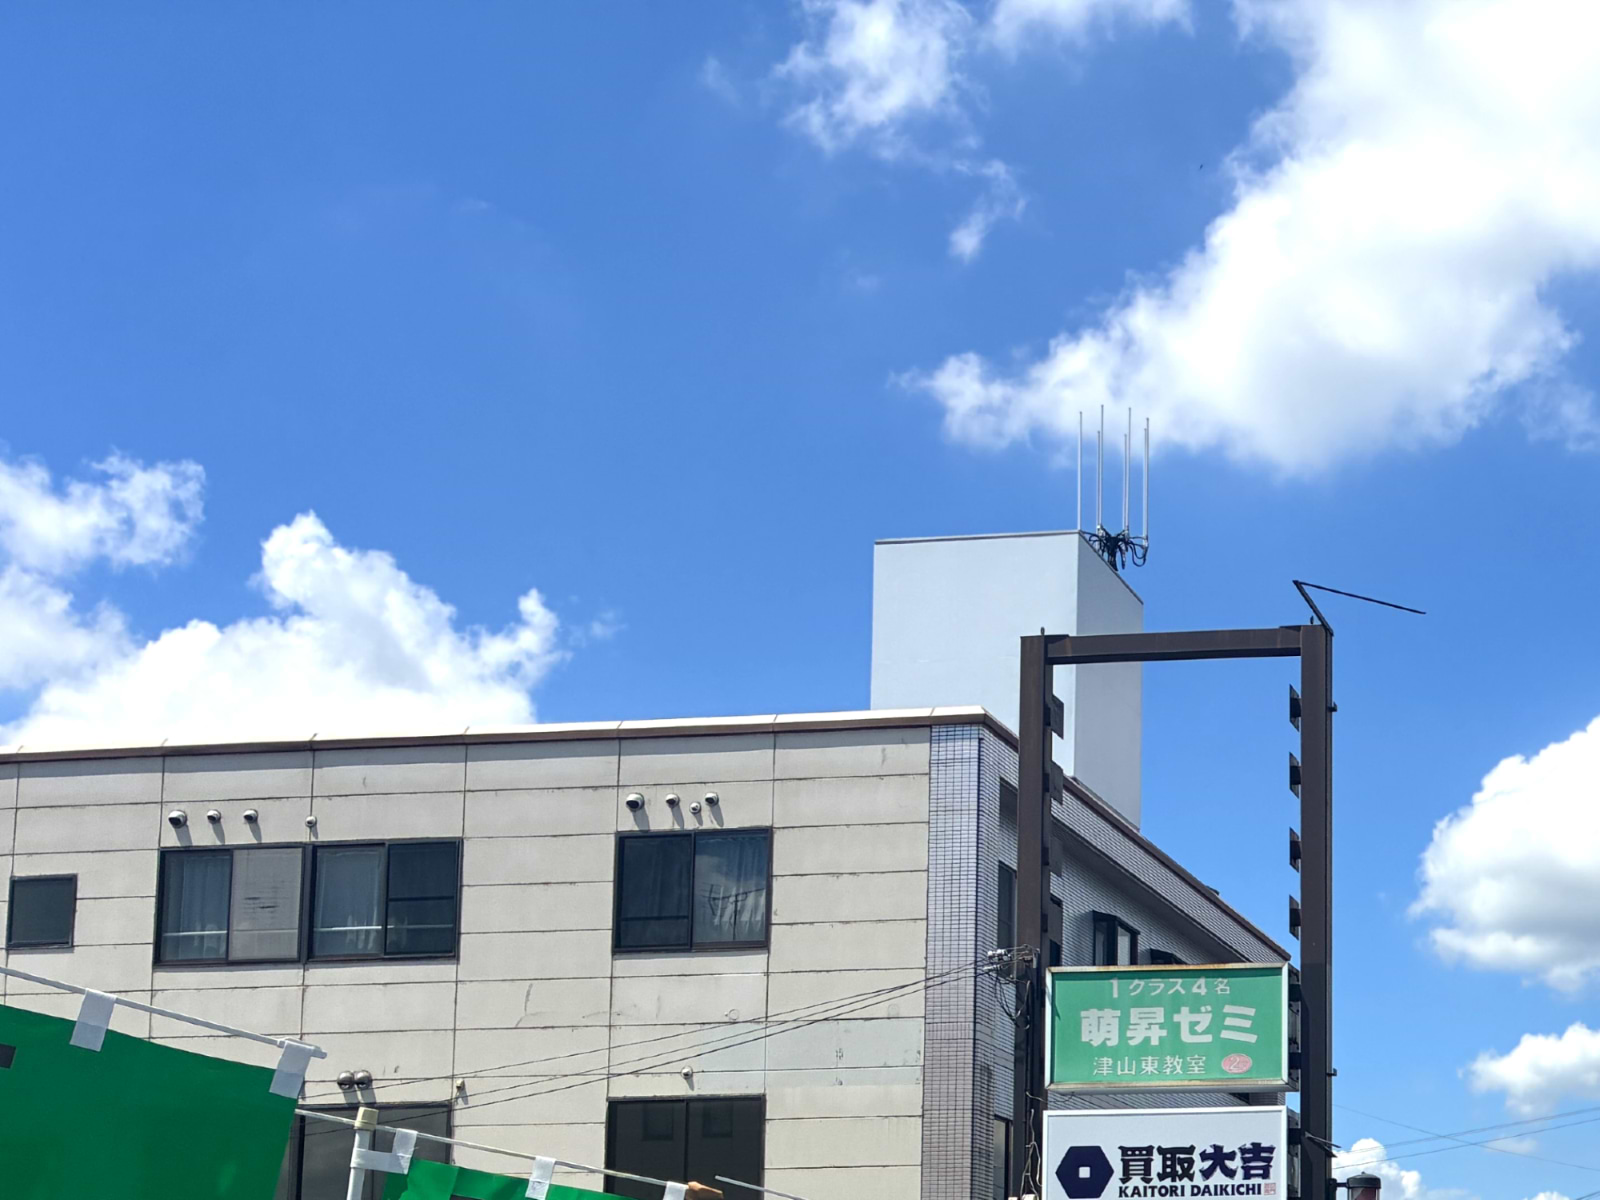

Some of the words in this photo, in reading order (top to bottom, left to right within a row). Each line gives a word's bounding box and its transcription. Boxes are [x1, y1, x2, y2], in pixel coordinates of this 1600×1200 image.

[1080, 1004, 1258, 1047] 萌昇ゼミ
[1092, 1054, 1207, 1077] 津山東教室
[1118, 1142, 1276, 1184] 買取大吉
[1118, 1184, 1185, 1198] KAITORI
[1190, 1183, 1262, 1197] DAIKICHI
